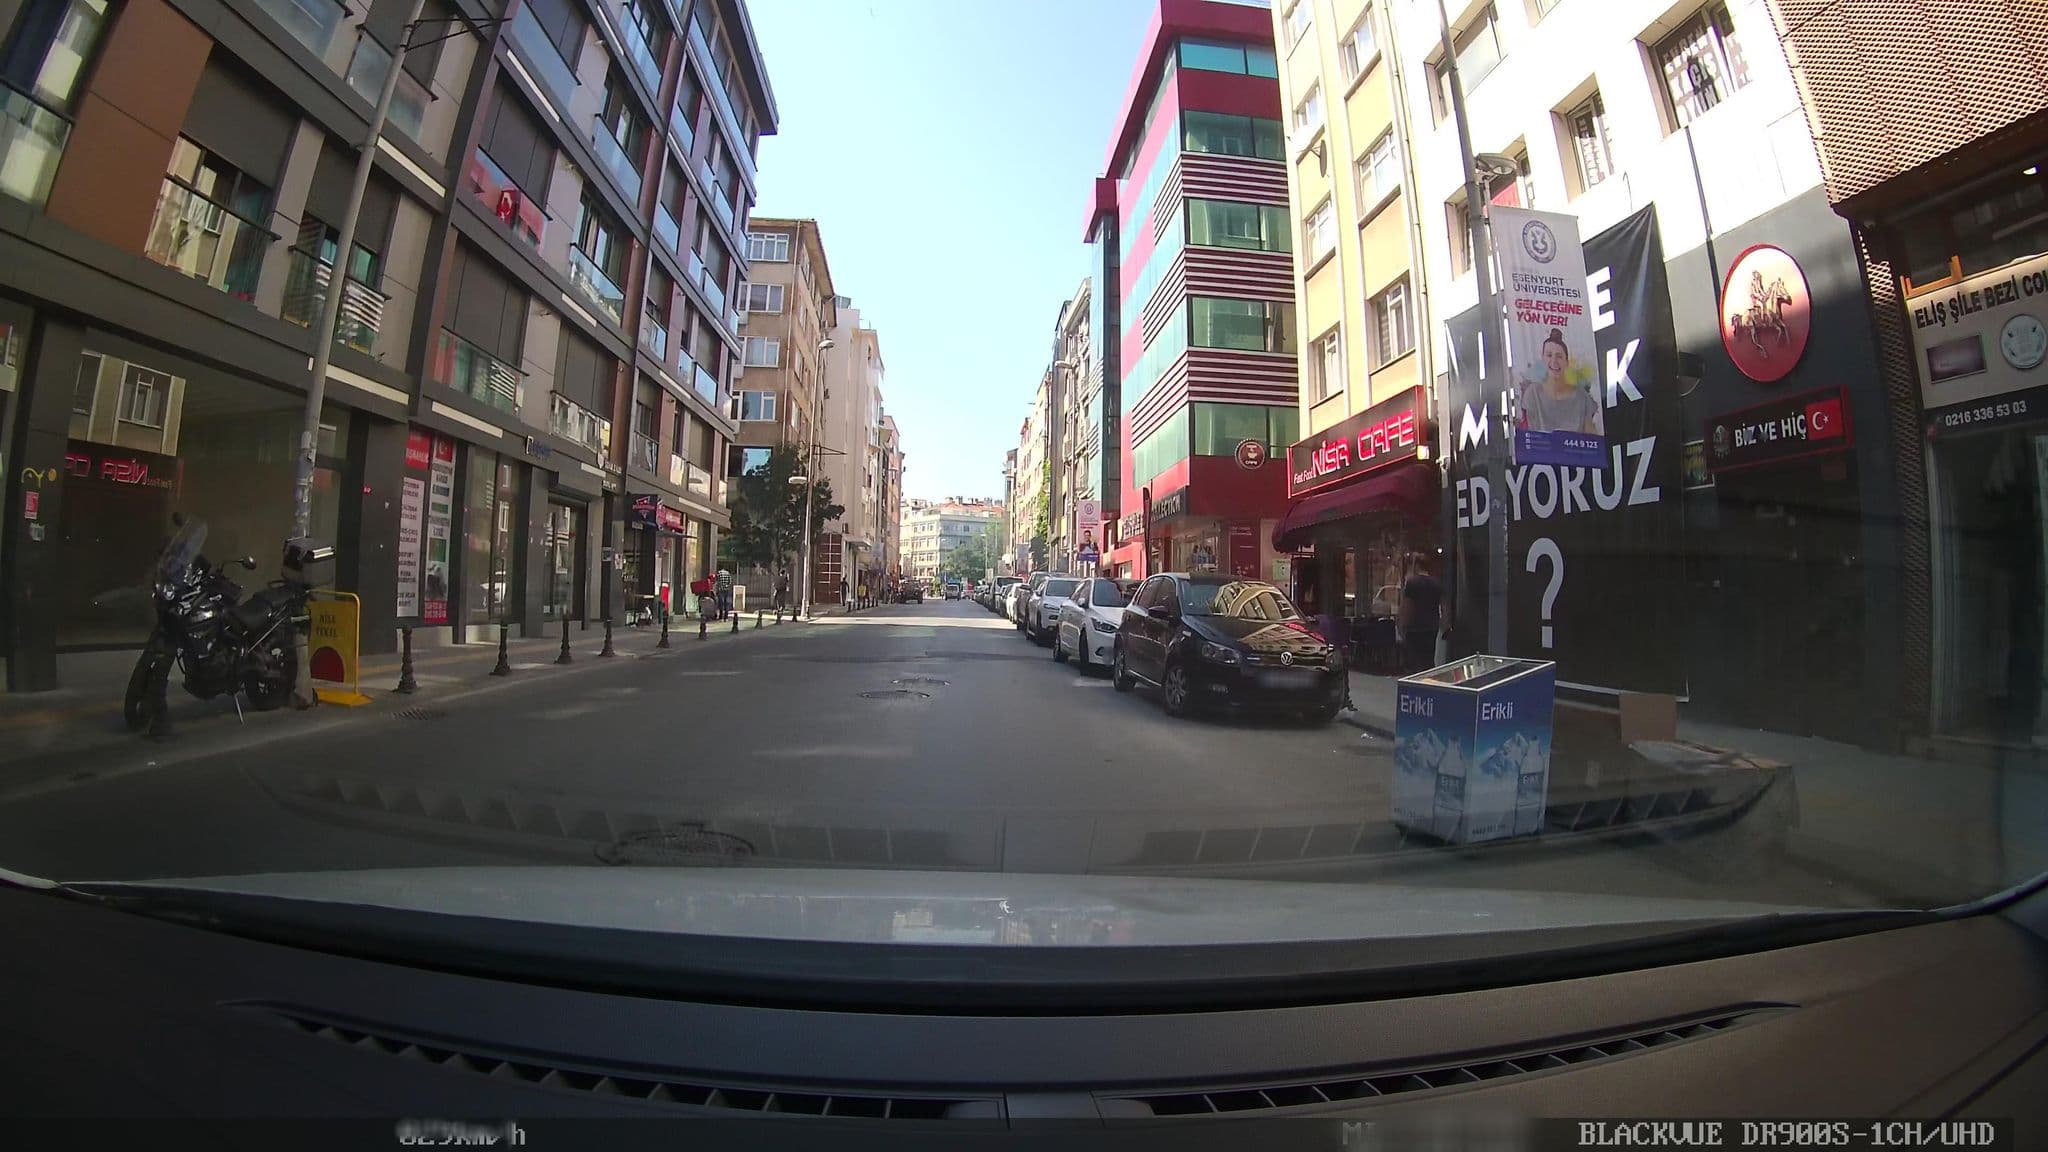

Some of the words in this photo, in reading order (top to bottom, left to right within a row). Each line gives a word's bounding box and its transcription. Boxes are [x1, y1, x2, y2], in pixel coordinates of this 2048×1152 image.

[1512, 273, 1564, 287] ESENYURT
[1513, 280, 1581, 298] ÜNİVERSİTESİ
[1514, 298, 1583, 316] GELECEĞİNE
[1914, 299, 1947, 329] ELİŞ
[1949, 291, 1983, 324] ŞİLE
[1984, 275, 2020, 310] BEZİ
[1516, 311, 1540, 324] YÖN
[1543, 313, 1569, 327] VER!
[1946, 410, 1971, 427] 0216
[1973, 407, 1994, 422] 336
[1996, 403, 2010, 417] 53
[2012, 400, 2027, 414] 03
[1357, 409, 1414, 461] CAFE
[1781, 412, 1807, 441] HİÇ
[1563, 439, 1578, 448] 444
[1579, 440, 1585, 448] 9
[1586, 440, 1599, 449] 123
[1455, 435, 1661, 529] EDYORUZ
[1525, 537, 1565, 649] ?
[1400, 694, 1434, 718] Erikli
[1481, 702, 1513, 721] Erikli
